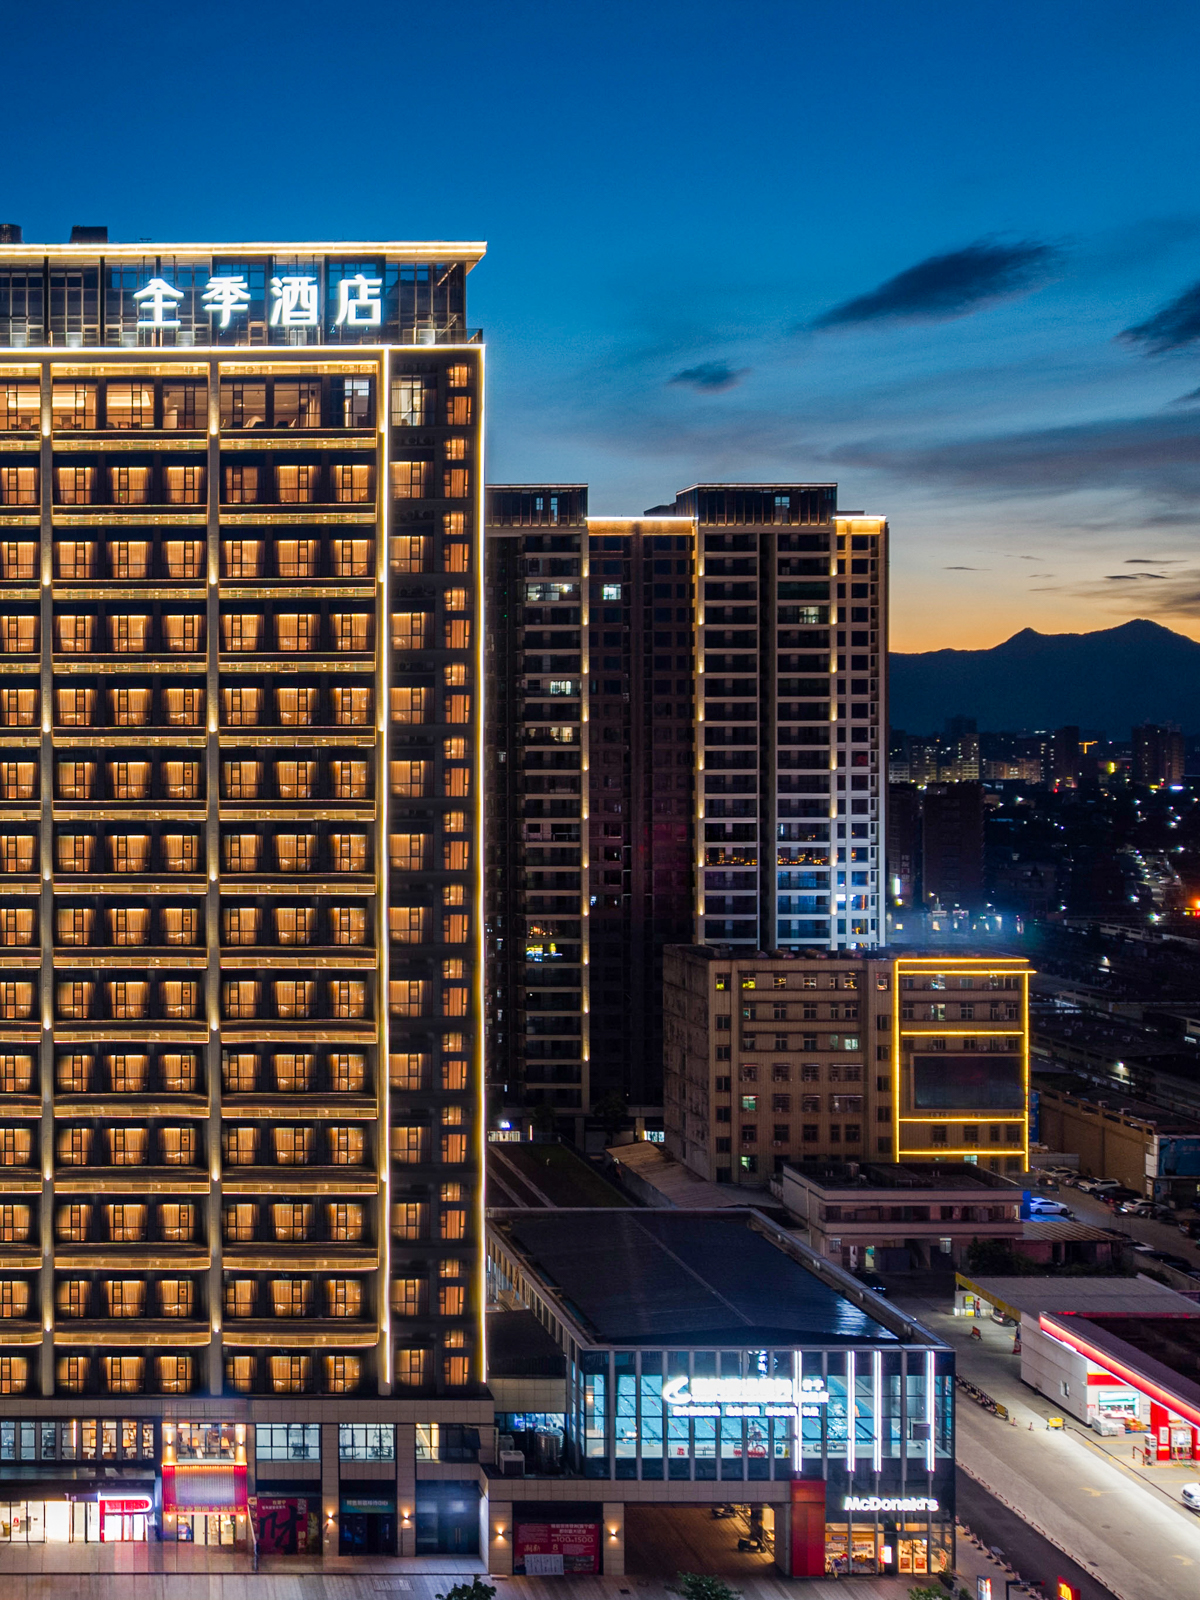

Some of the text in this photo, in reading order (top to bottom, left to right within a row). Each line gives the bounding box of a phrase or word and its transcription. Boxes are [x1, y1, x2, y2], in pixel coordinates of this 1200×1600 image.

[133, 274, 383, 328] 全季酒店
[844, 1496, 939, 1512] McDonald's
